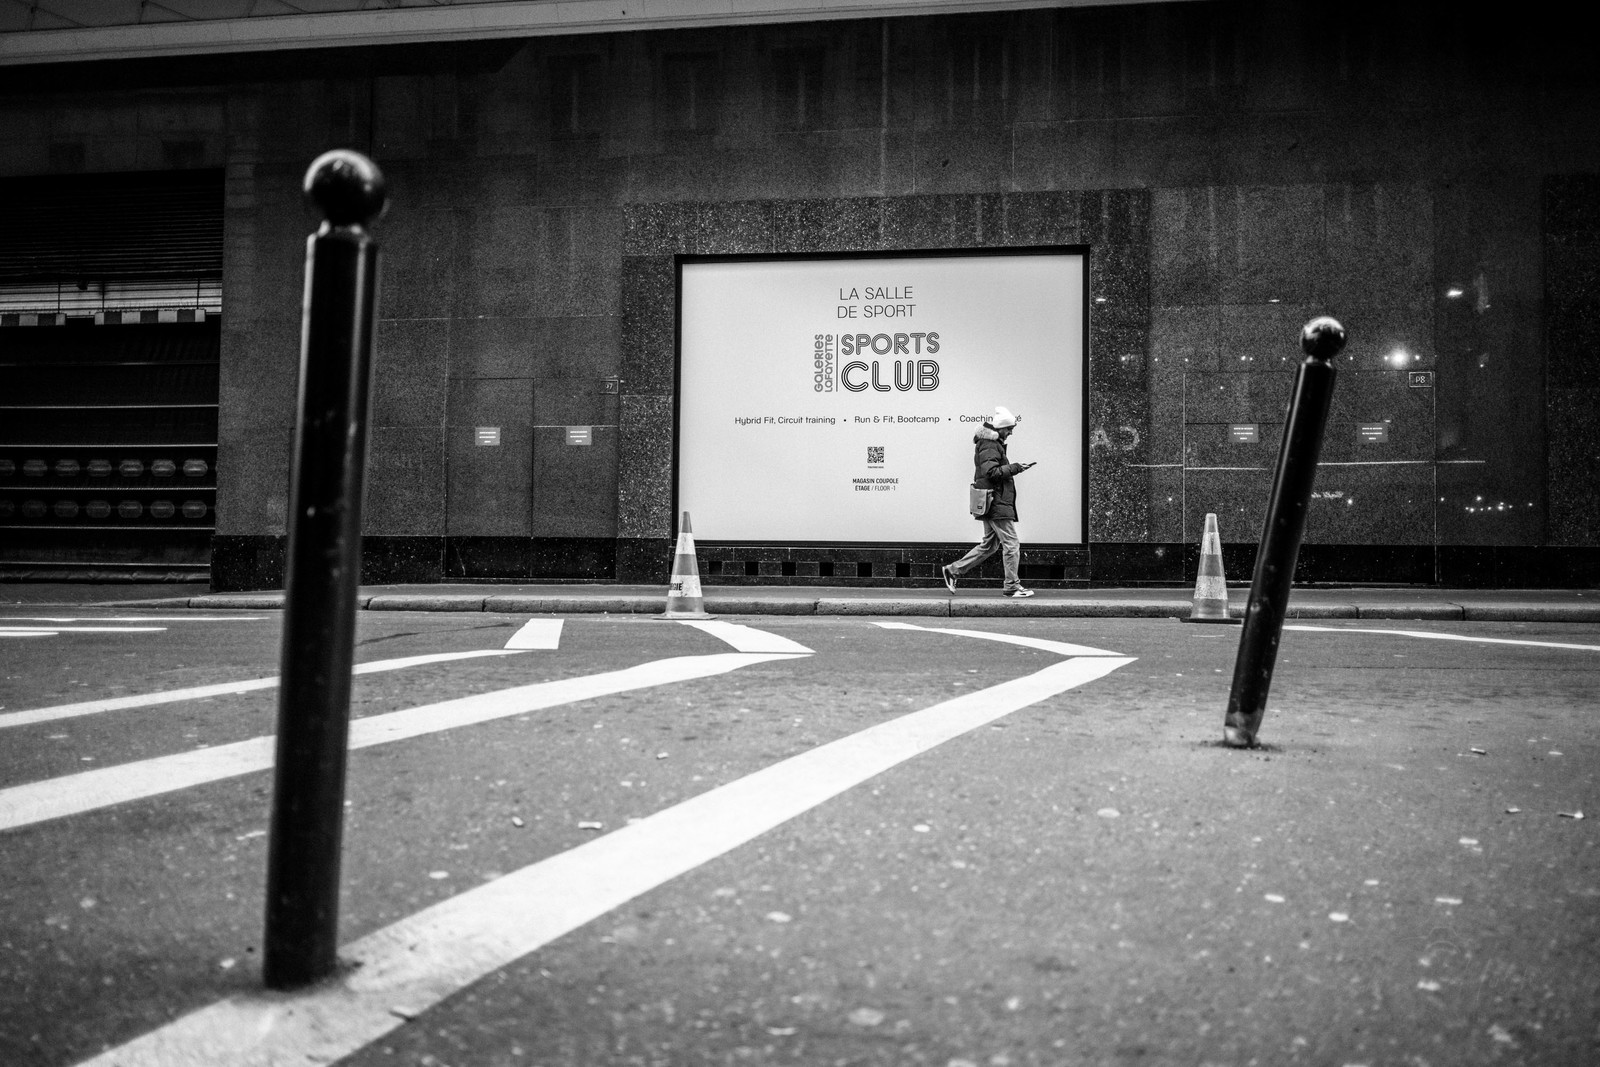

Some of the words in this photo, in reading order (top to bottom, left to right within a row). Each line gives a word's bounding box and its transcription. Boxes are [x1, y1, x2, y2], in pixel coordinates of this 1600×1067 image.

[839, 287, 859, 301] LA
[864, 286, 914, 300] SALLE
[837, 305, 858, 319] DE
[863, 304, 917, 319] SPORT
[841, 332, 940, 356] SPORTS
[841, 359, 940, 393] CLUB
[734, 416, 762, 426] Hybrid
[764, 416, 777, 425] Fit,
[778, 416, 804, 425] Circuit
[805, 416, 836, 425] training
[854, 415, 871, 424] Run
[873, 415, 881, 424] &
[883, 415, 896, 424] Fit,
[897, 415, 941, 425] Bootcamp
[959, 414, 994, 423] Coachin
